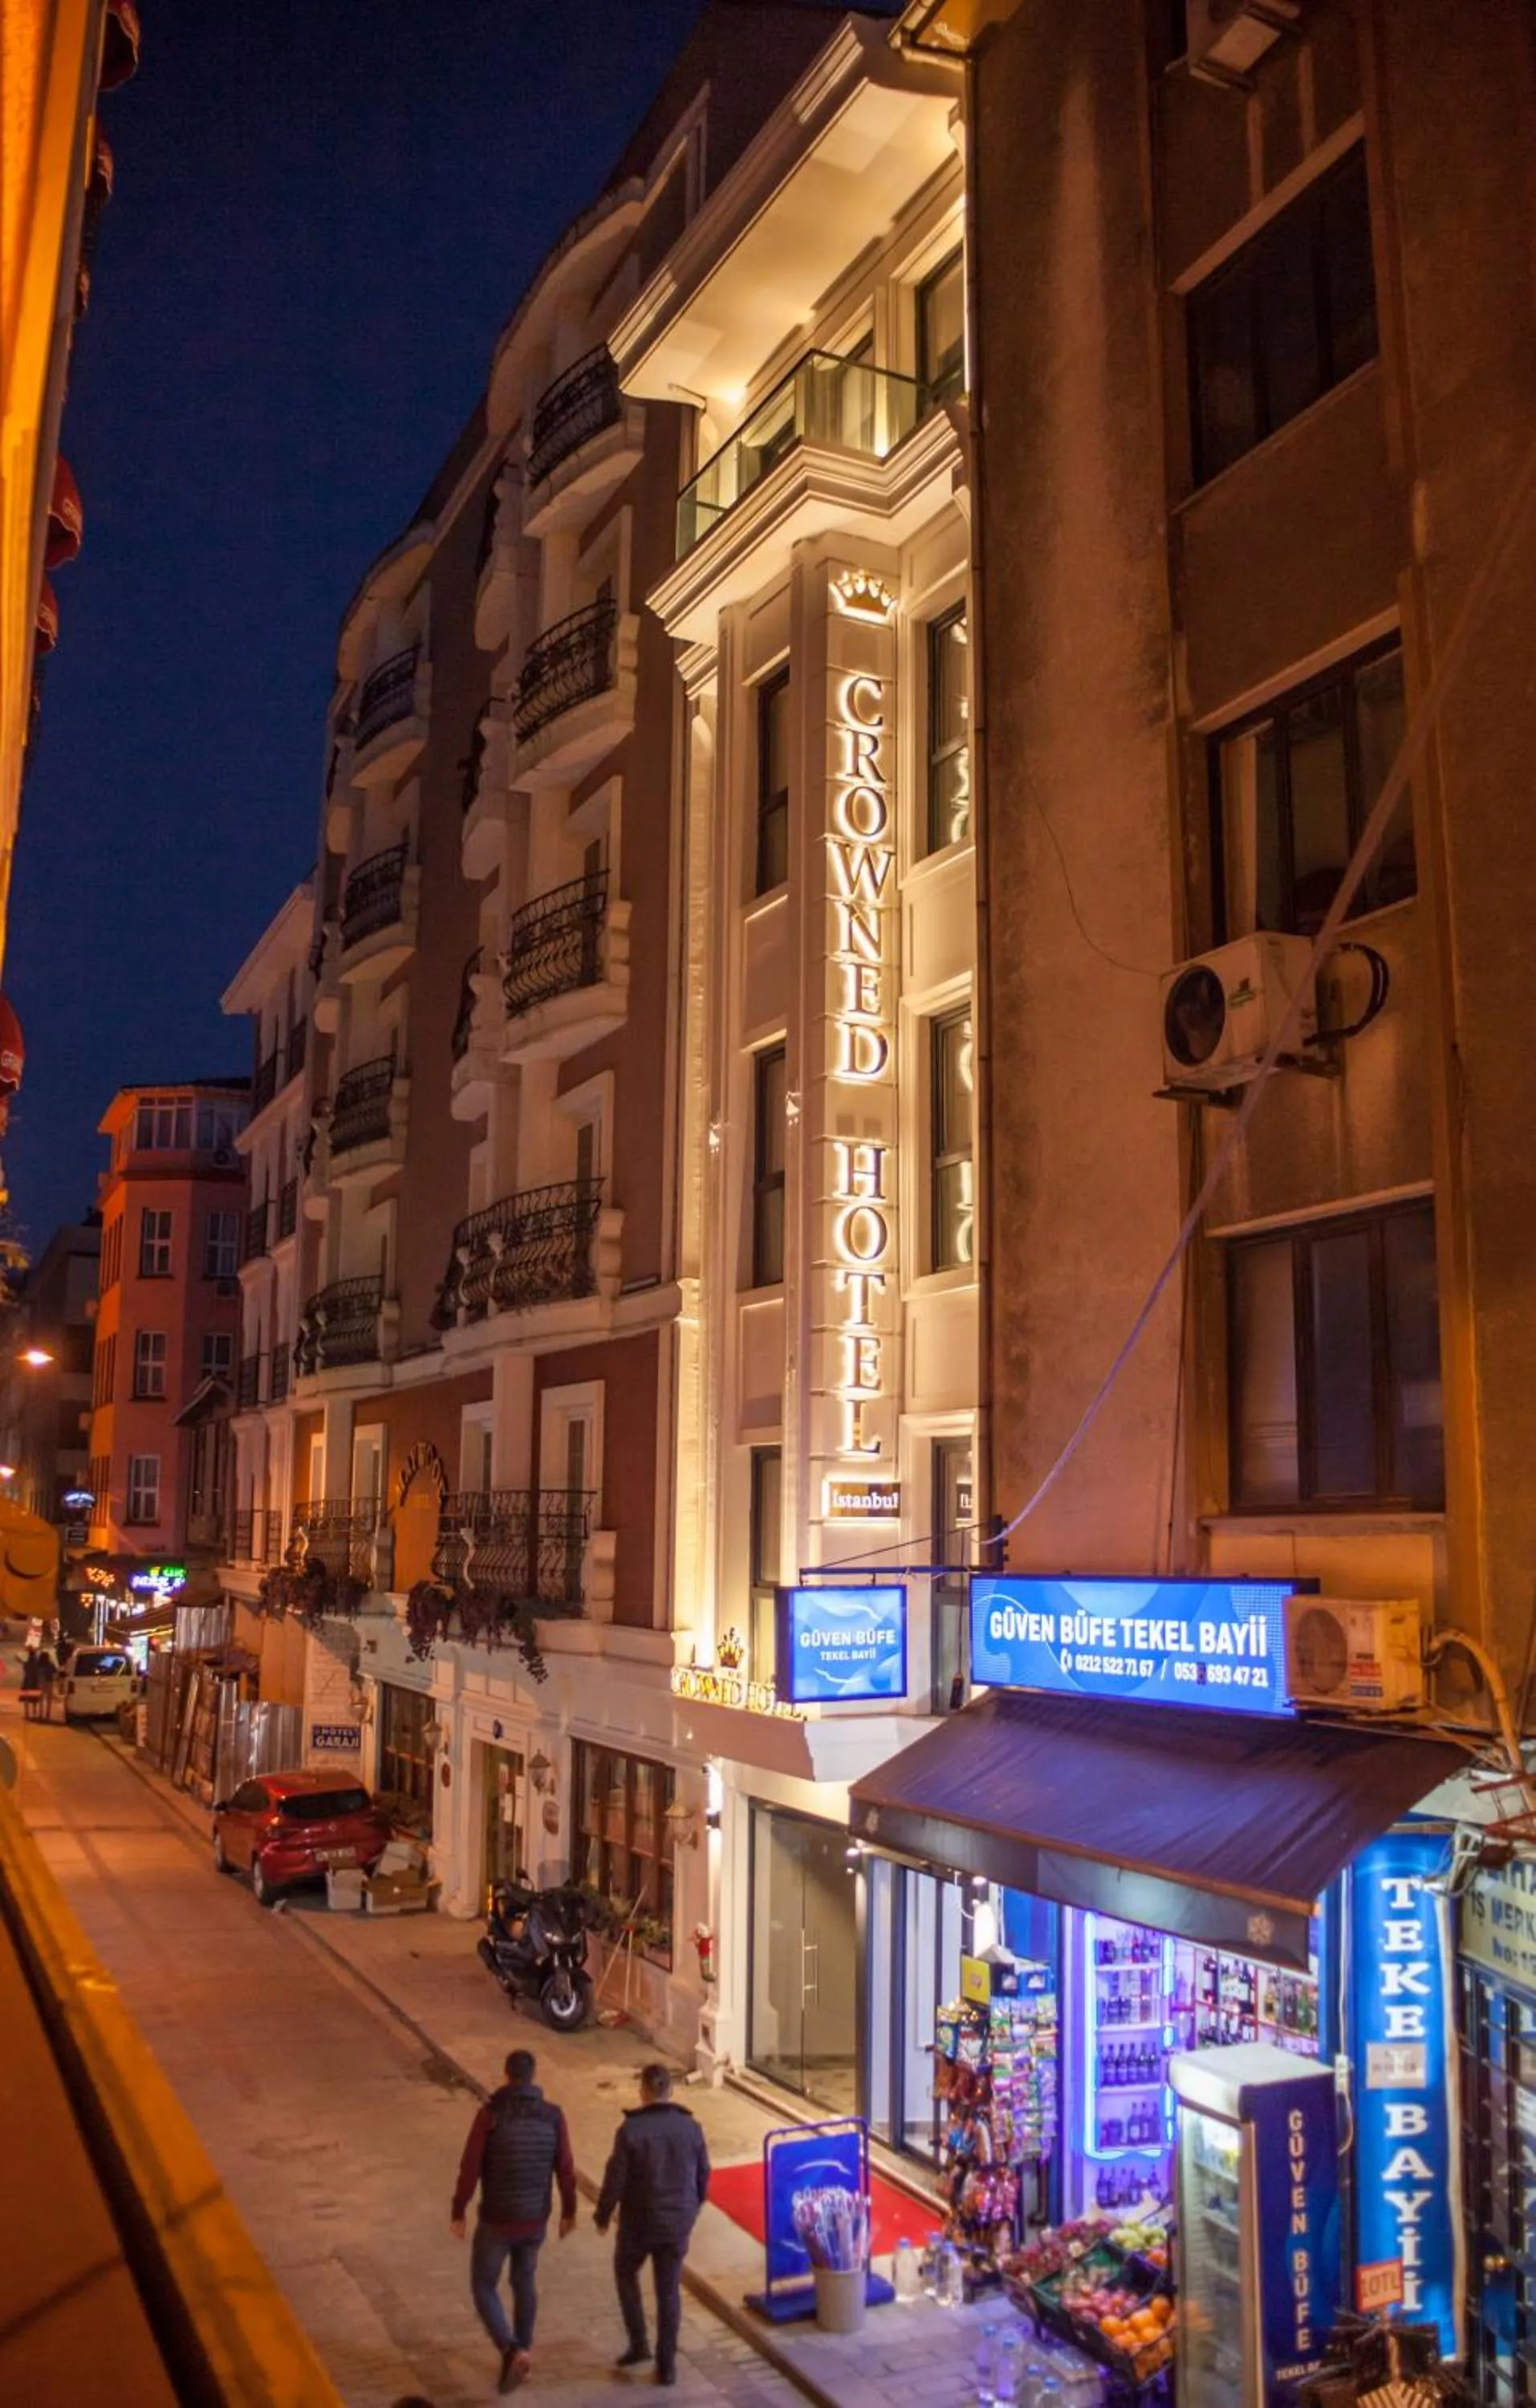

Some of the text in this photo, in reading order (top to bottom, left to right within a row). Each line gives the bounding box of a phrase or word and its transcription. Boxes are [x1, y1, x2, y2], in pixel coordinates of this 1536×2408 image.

[829, 677, 892, 1454] CROWNED HOTEL
[800, 1628, 896, 1648] GÜVEN BÜFE
[989, 1606, 1055, 1642] GÜVEN
[1060, 1609, 1117, 1648] BÜFE
[1120, 1618, 1195, 1652] TEKEL
[820, 1650, 851, 1661] TEKEL
[1075, 1654, 1102, 1674] 0212
[1103, 1657, 1124, 1675] 522
[1288, 2109, 1310, 2352] GÜVEN BÜFE
